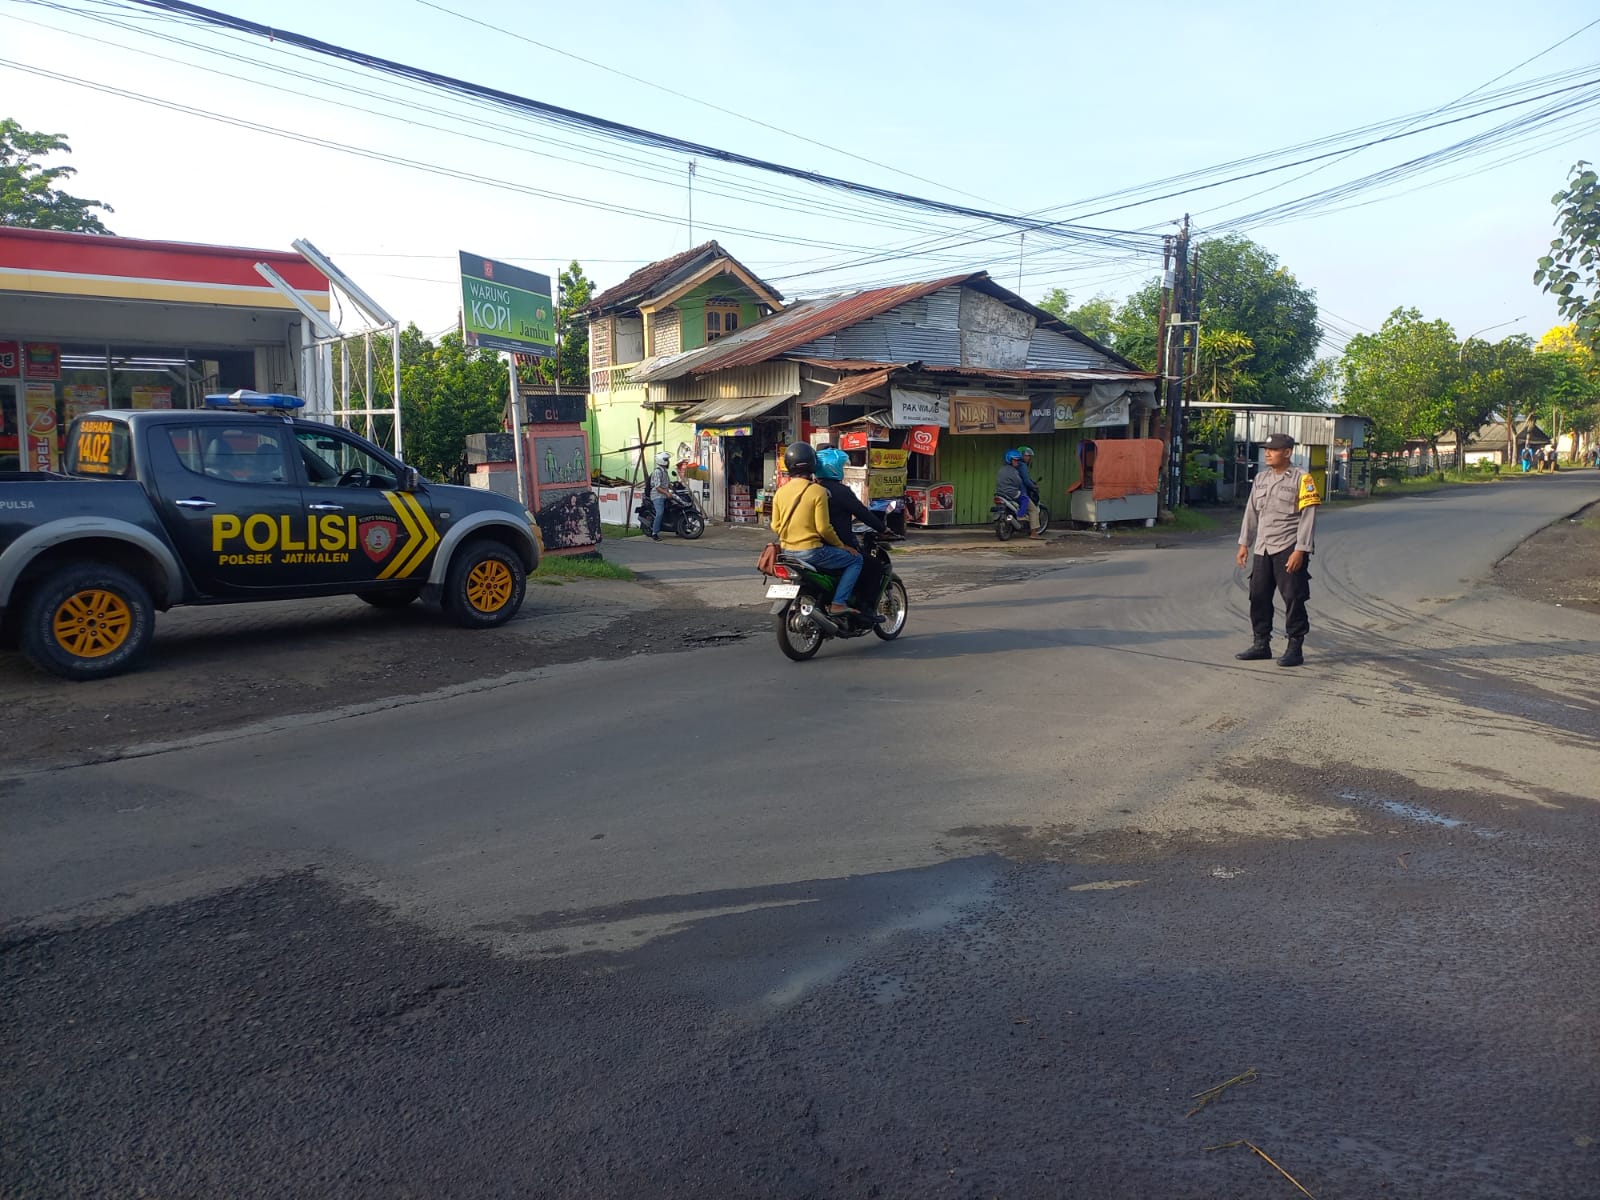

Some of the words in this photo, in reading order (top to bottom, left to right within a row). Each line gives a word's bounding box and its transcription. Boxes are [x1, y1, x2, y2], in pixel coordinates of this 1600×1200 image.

[470, 282, 510, 304] WARUNG
[472, 300, 513, 333] KOPI
[520, 320, 550, 340] Jambu
[80, 421, 113, 433] SABHARA
[78, 434, 110, 463] 14.02
[212, 514, 357, 551] POLISI
[219, 554, 272, 565] POLSEK
[281, 553, 349, 564] JATIKALEN
